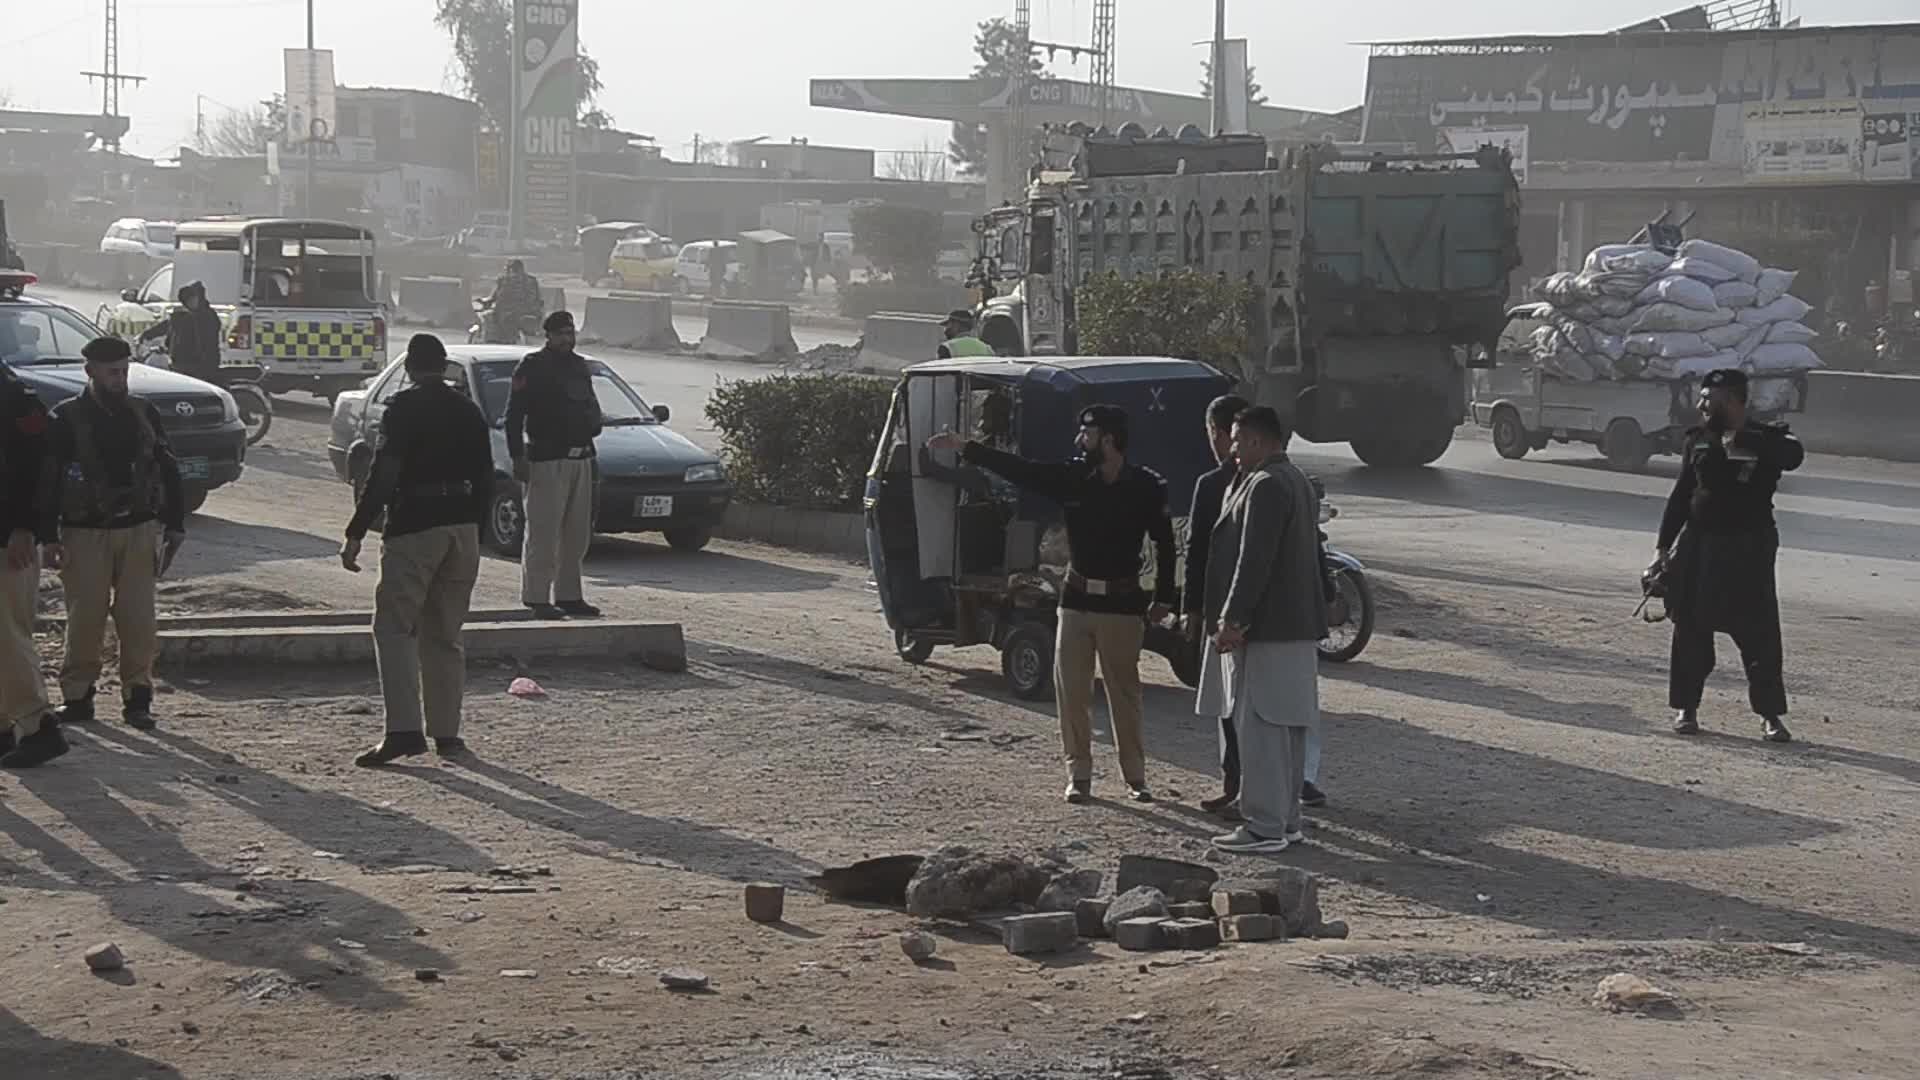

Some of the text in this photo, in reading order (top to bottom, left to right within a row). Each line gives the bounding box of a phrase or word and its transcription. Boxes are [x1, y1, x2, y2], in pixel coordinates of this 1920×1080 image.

[526, 5, 567, 24] CNG
[1030, 85, 1060, 101] CNG
[525, 116, 571, 154] CNG
